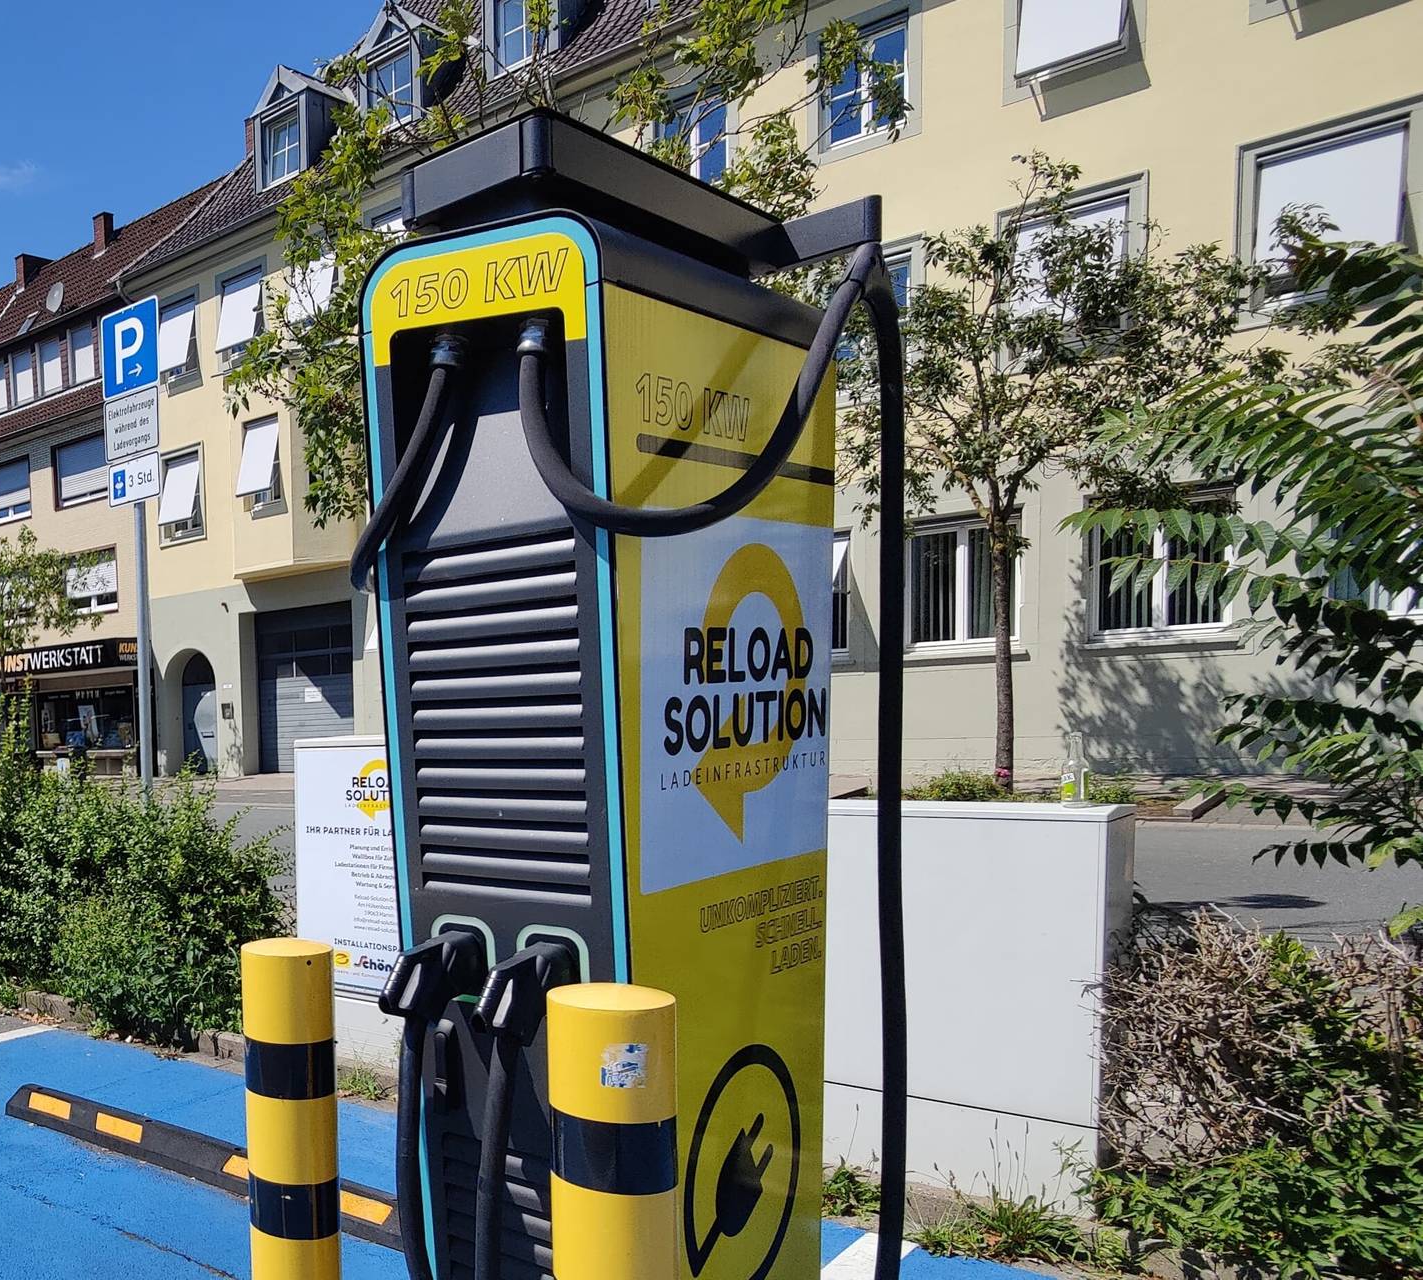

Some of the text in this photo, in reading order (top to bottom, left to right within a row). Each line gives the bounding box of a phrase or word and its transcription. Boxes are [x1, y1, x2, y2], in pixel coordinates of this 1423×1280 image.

[389, 247, 569, 318] 150 KW
[114, 317, 144, 385] P
[108, 398, 154, 421] Elektrofahrzeuge
[635, 373, 750, 442] 150 KW
[114, 417, 149, 435] während des
[113, 433, 151, 451] Ladevorgangs
[129, 470, 155, 487] 3 Std.
[119, 642, 137, 653] KUN
[683, 627, 813, 685] RELOAD
[664, 688, 826, 756] SOLUTION
[660, 750, 826, 791] LADEINFRASTRUKTUR
[352, 777, 389, 788] RELO
[346, 789, 389, 801] SOLUT
[306, 826, 320, 834] IHR
[323, 827, 361, 836] PARTNER
[363, 826, 380, 836] FÜR
[699, 875, 823, 933] UNKOMPLIZIERT.
[755, 915, 823, 949] SCHNELL.
[334, 938, 398, 952] INSTALLATIONSP
[770, 938, 822, 974] LADEN.
[354, 955, 393, 972] Schön
